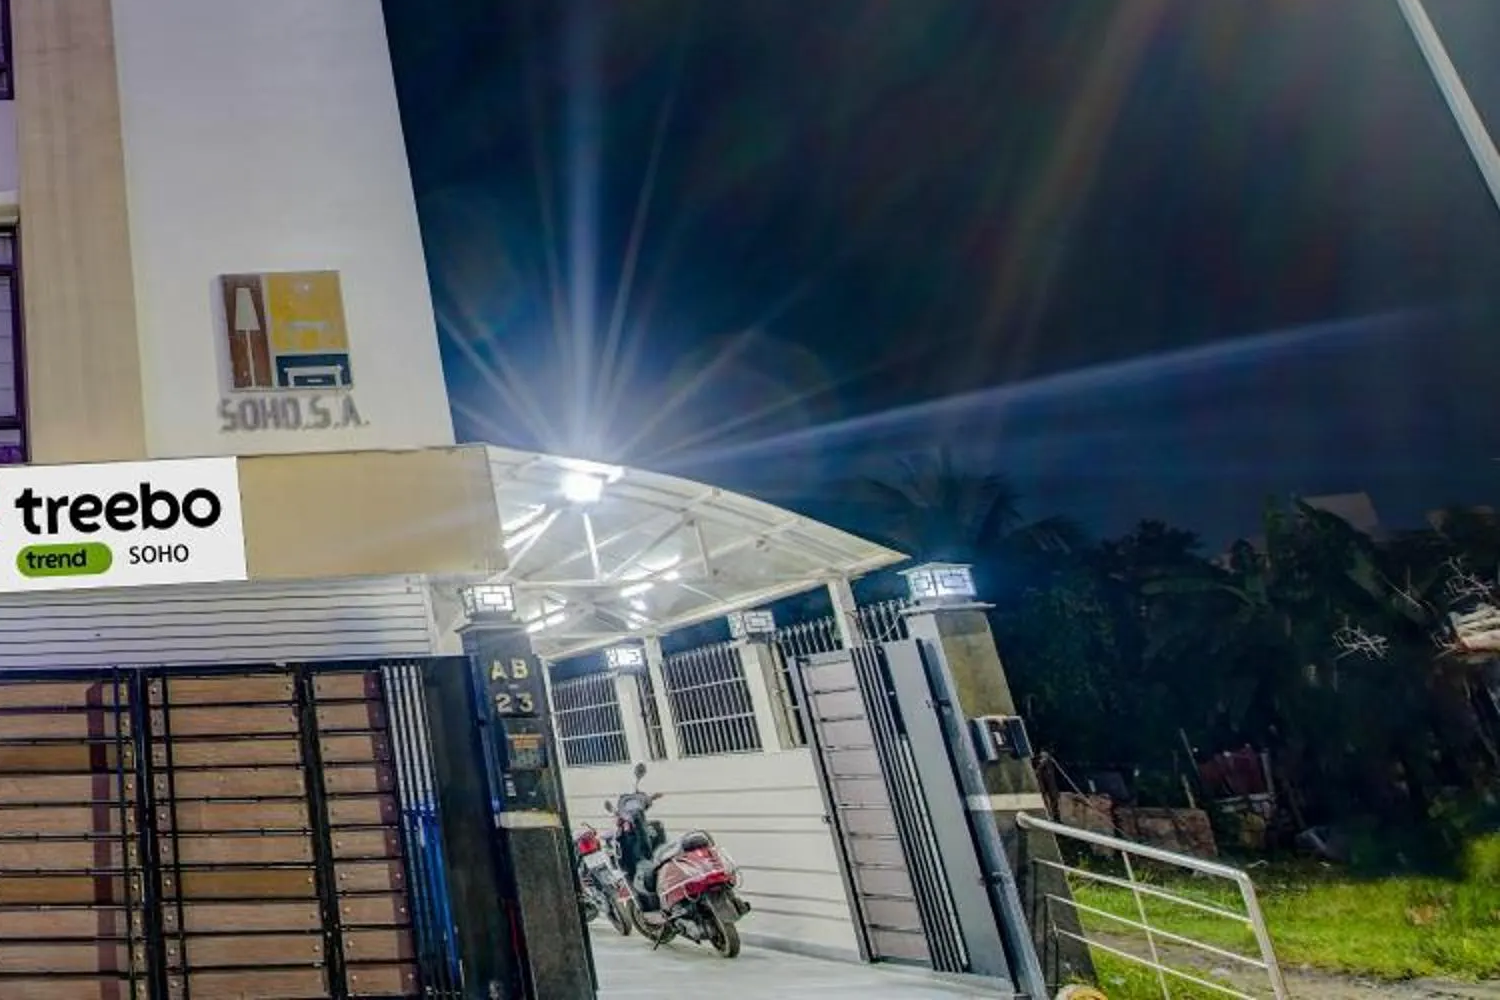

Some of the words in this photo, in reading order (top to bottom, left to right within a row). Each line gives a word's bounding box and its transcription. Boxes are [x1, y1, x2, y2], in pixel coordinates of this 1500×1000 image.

[15, 481, 221, 534] treebo
[26, 549, 87, 570] trend
[129, 544, 190, 565] SOHO
[495, 693, 534, 713] 23
